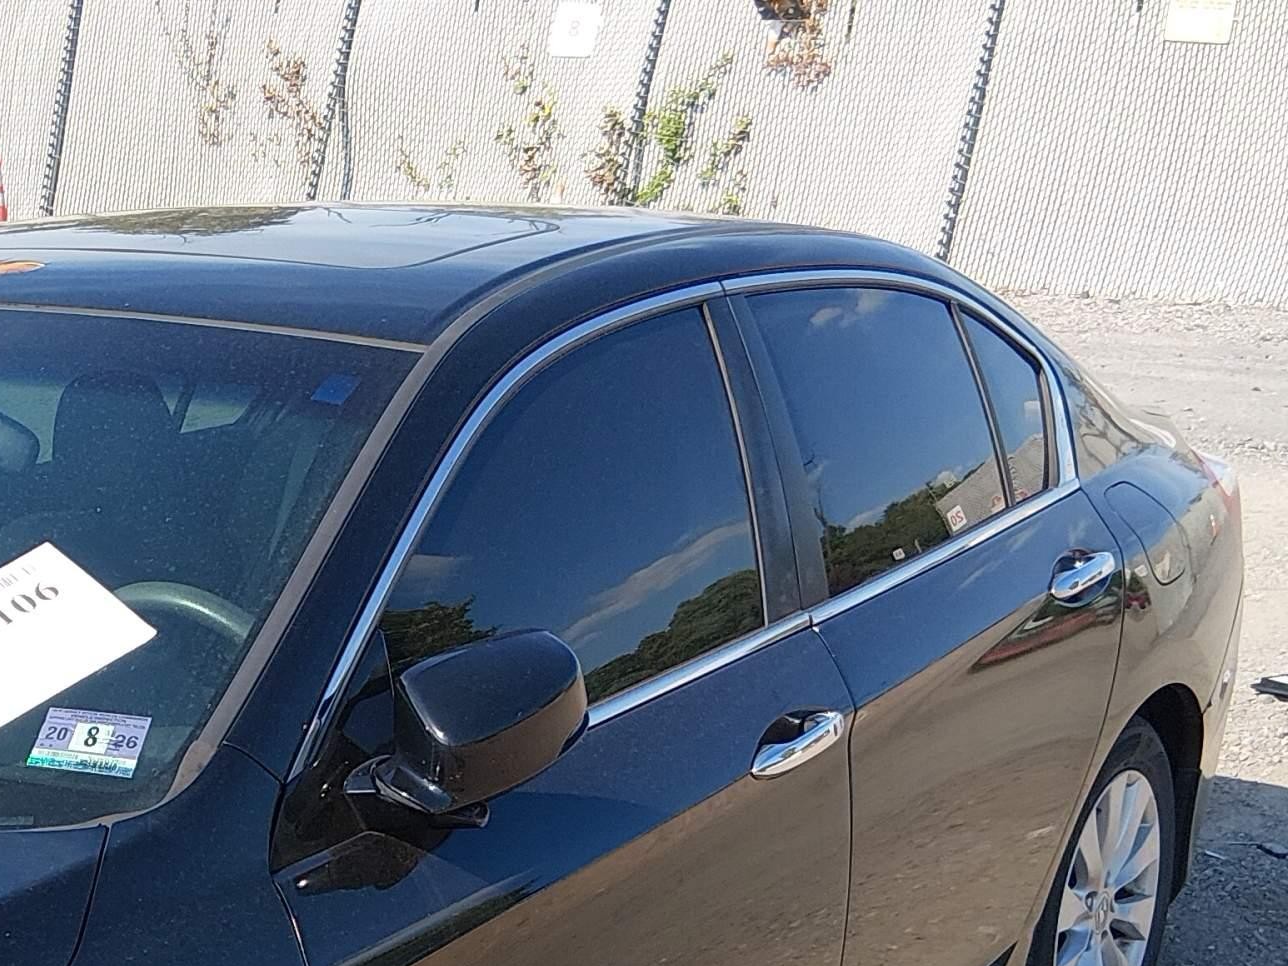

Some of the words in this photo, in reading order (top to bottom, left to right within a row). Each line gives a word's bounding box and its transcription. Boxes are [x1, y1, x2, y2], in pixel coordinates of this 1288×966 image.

[568, 20, 581, 37] 8
[45, 726, 68, 741] 20
[83, 726, 100, 747] 8
[113, 734, 139, 749] 26
